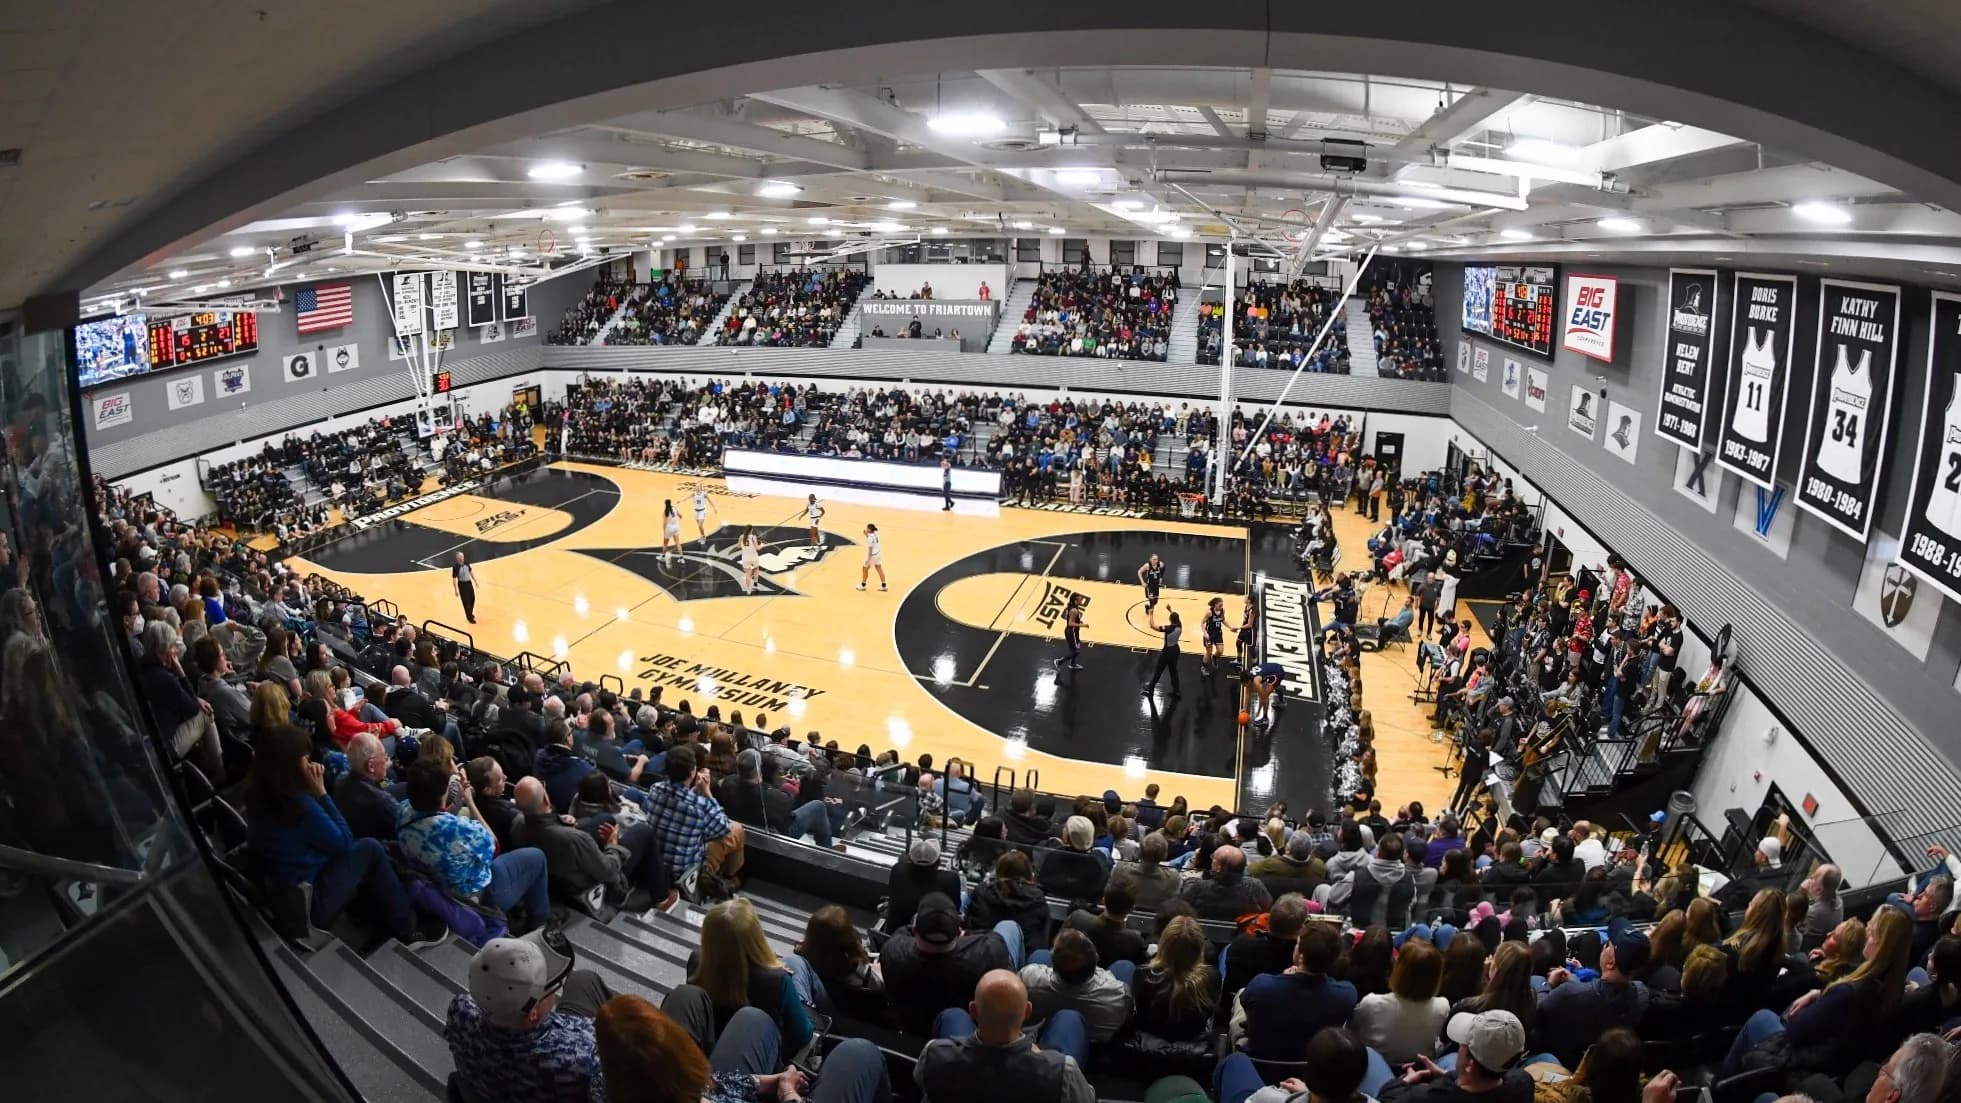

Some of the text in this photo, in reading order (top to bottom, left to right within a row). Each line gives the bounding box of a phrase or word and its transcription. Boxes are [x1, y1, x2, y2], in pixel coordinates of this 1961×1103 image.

[1576, 286, 1606, 308] BIG
[1751, 286, 1778, 303] DORIS
[862, 303, 992, 316] WELCOME TO FRIARTOWN
[1571, 307, 1611, 331] EAST
[1748, 303, 1779, 322] BURKE
[1840, 295, 1879, 319] KATHY
[1830, 315, 1884, 343] FINN HILL
[290, 355, 309, 377] G
[102, 396, 124, 409] BIG
[1746, 381, 1763, 412] 11
[99, 404, 129, 419] EAST
[1832, 408, 1859, 448] 34
[1724, 439, 1771, 472] 1983-1987
[1686, 450, 1713, 498] X
[351, 480, 481, 530] PROVIDENCE
[1806, 476, 1863, 520] 1980-1984
[475, 510, 511, 528] BIG
[479, 509, 527, 532] EAST
[1754, 483, 1787, 540] V
[1036, 585, 1072, 630] EAST
[640, 654, 689, 670] JOE
[684, 663, 826, 700] MULLANEY
